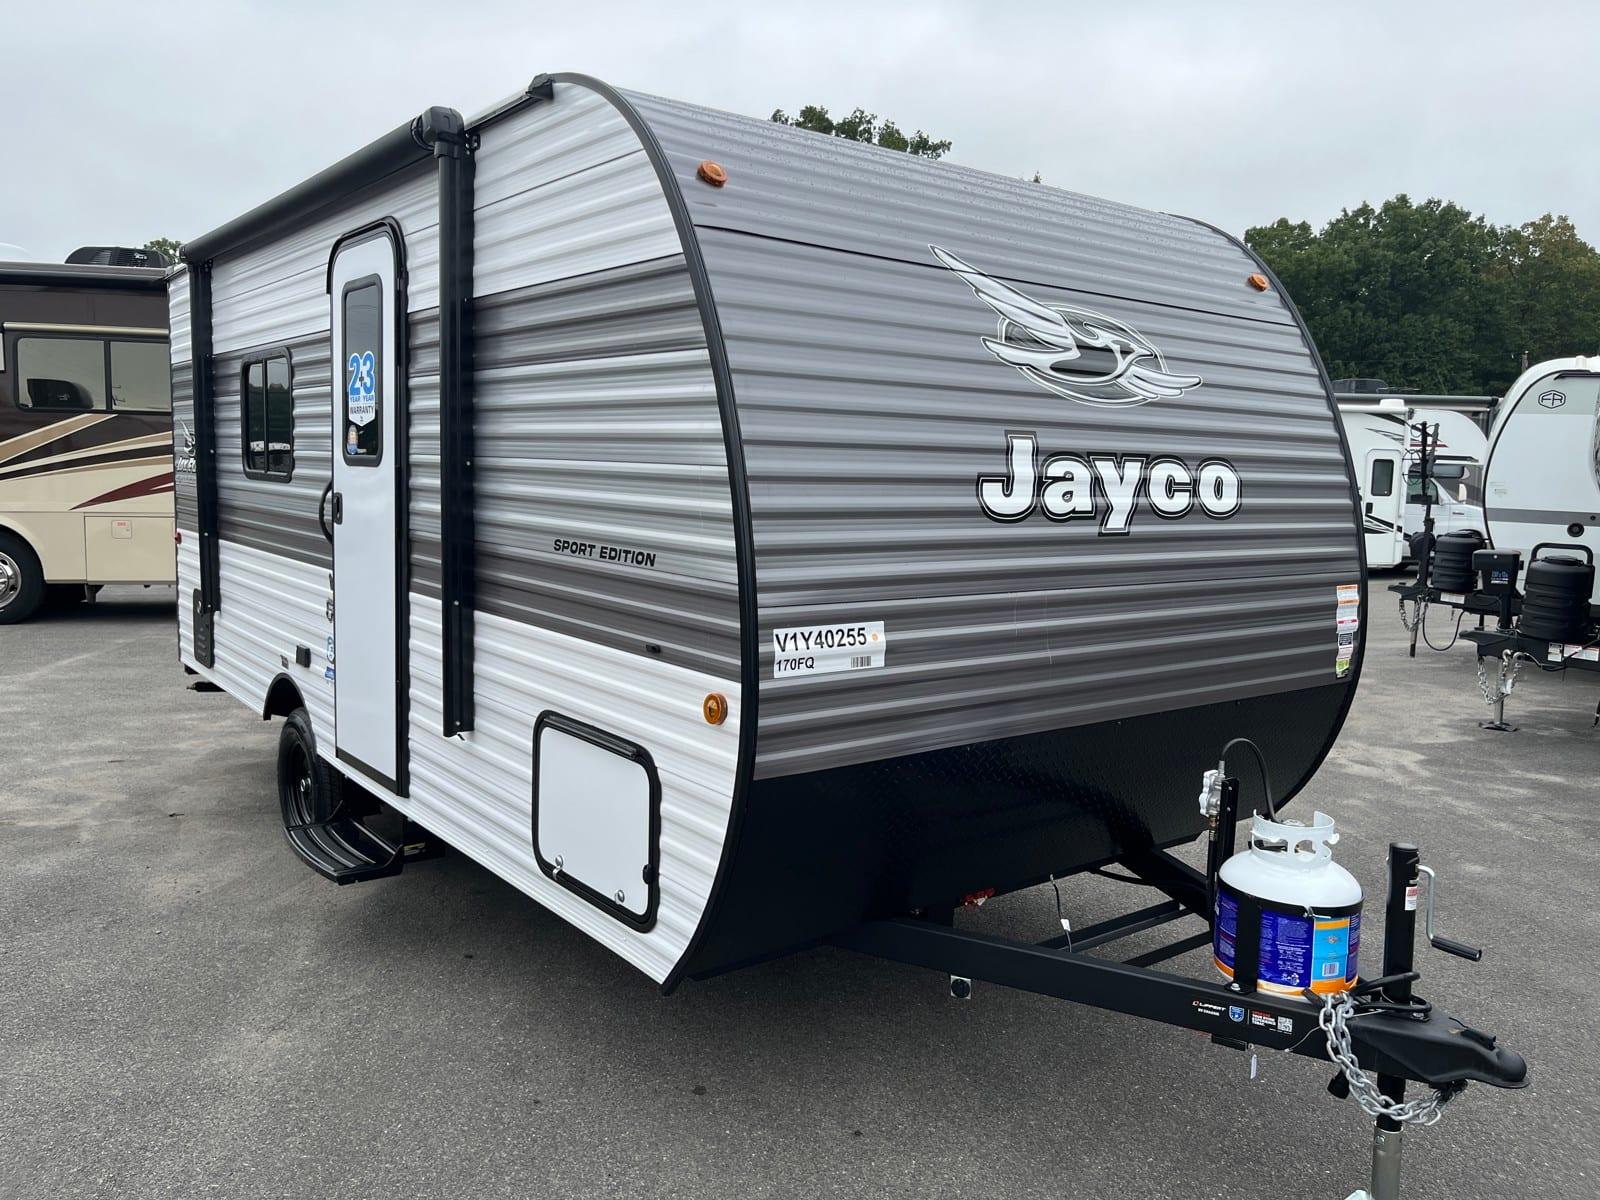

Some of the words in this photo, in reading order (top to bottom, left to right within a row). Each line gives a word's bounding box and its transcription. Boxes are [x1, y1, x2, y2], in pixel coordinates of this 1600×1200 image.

[350, 405, 374, 414] WARRANTY
[976, 430, 1242, 536] Jayco
[553, 539, 596, 557] SPORT
[599, 546, 656, 567] EDITION
[775, 627, 867, 653] V1Y40255
[776, 657, 815, 672] 170FQ
